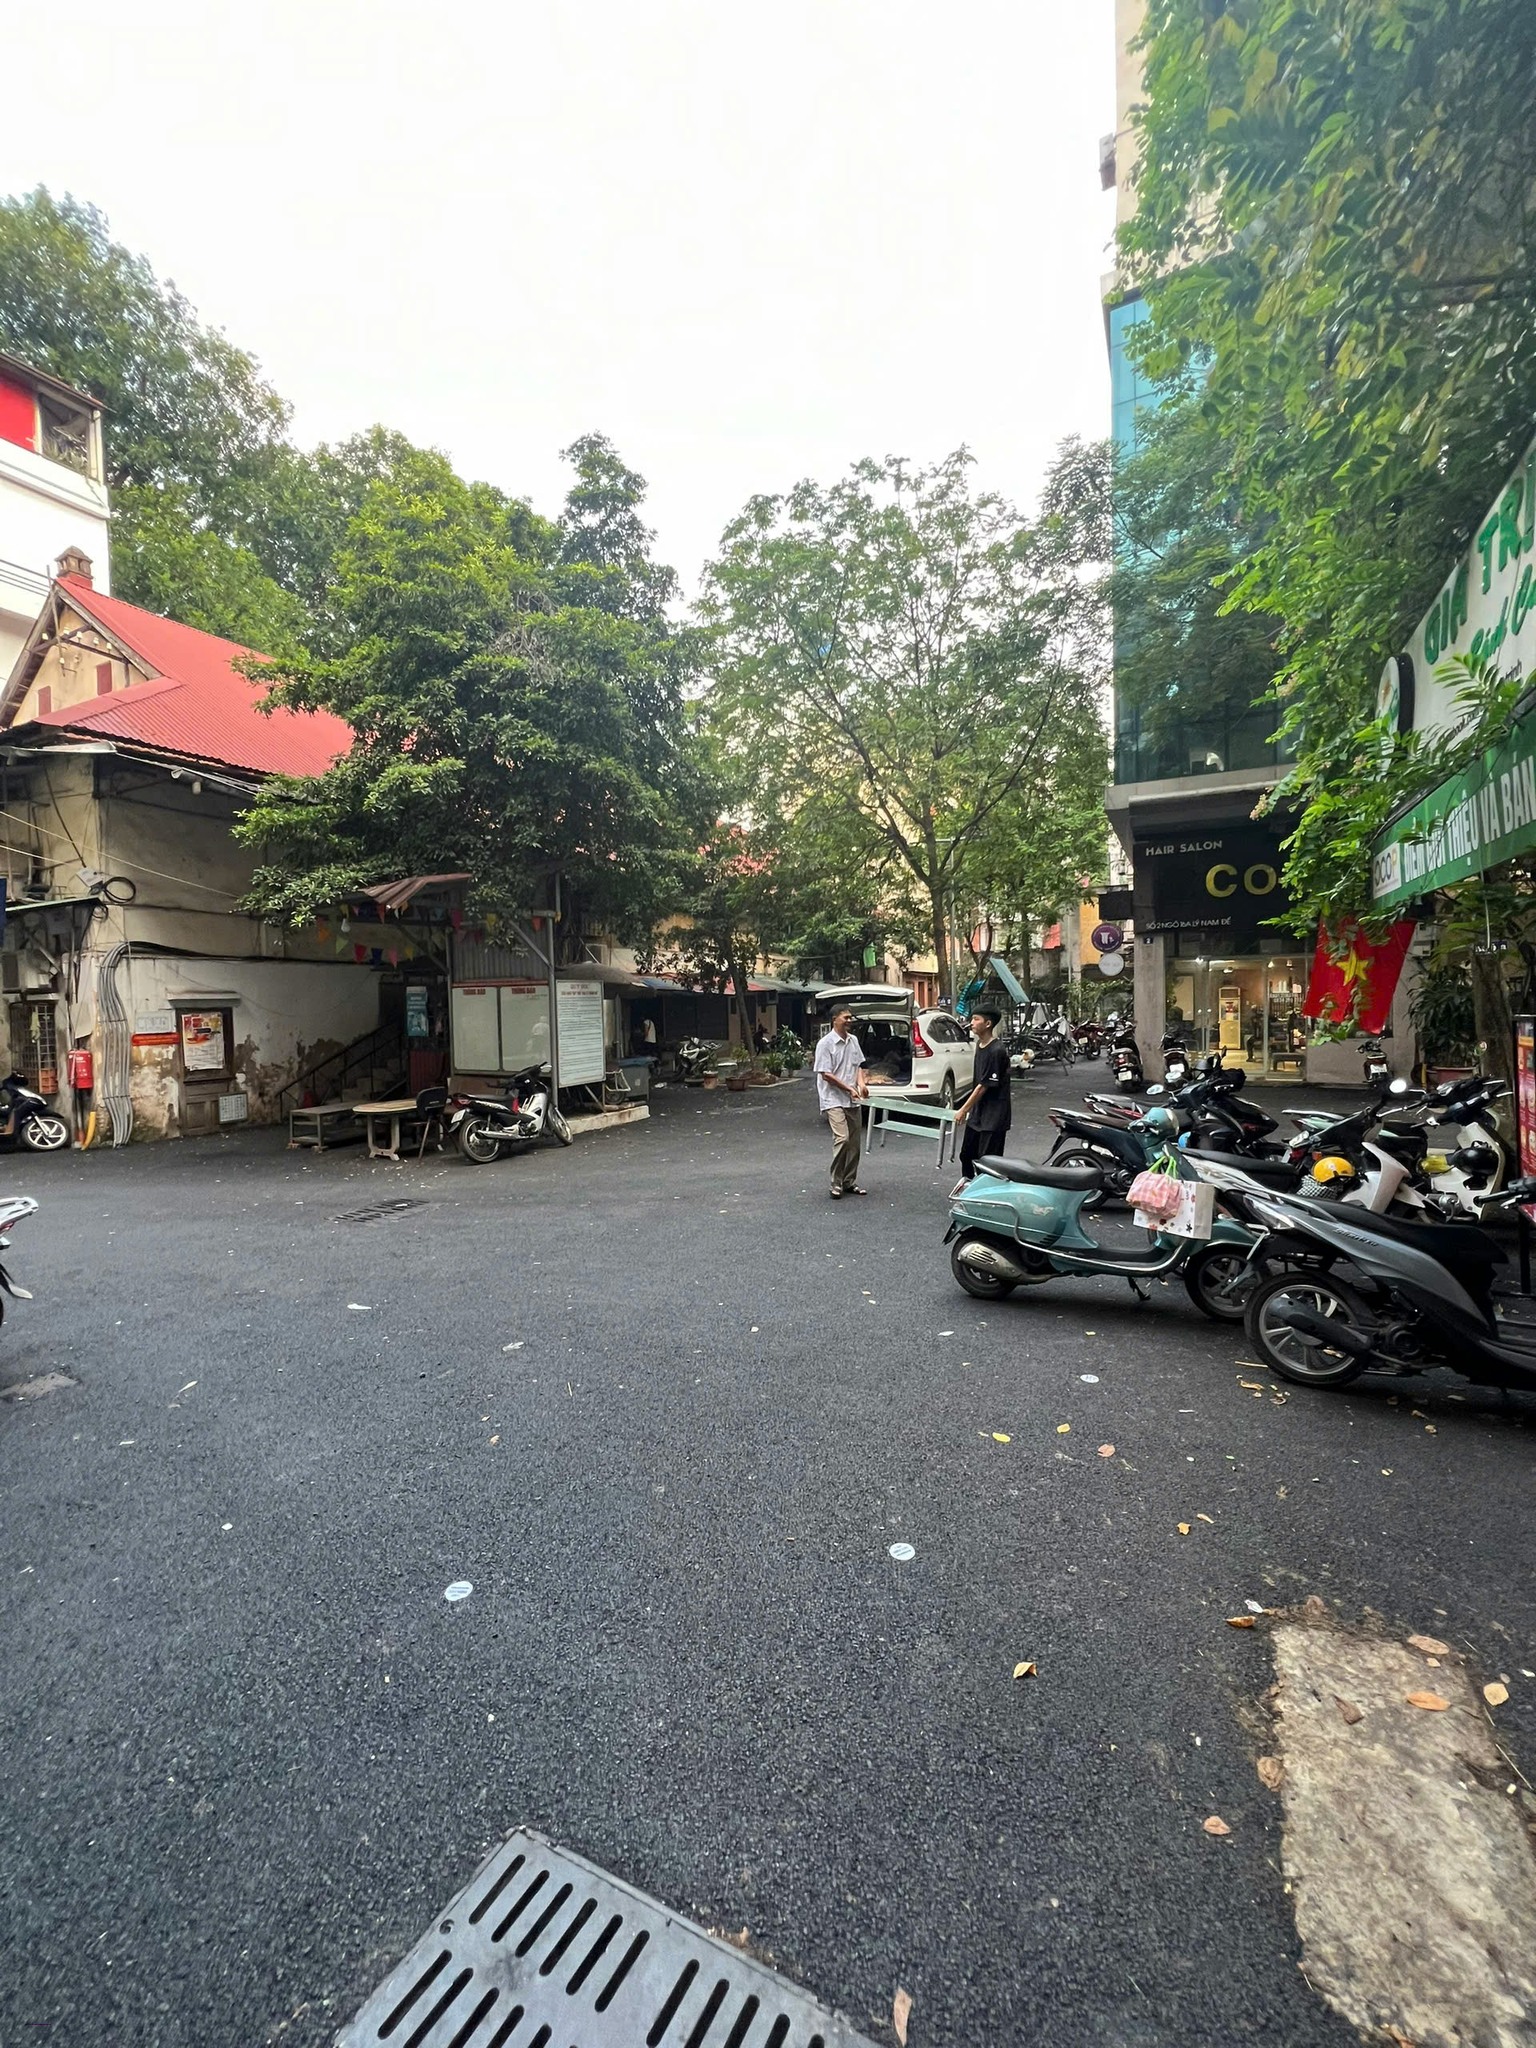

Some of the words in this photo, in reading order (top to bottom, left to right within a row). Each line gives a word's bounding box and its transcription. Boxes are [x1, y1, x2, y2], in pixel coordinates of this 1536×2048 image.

[1424, 556, 1469, 666] GIA
[1446, 788, 1480, 867] THIỆU
[1480, 771, 1502, 845] VÀ
[1501, 751, 1536, 835] BÁN
[1145, 845, 1175, 857] HAIR
[1180, 840, 1223, 854] SALON
[1206, 863, 1278, 898] CO
[1201, 919, 1220, 927] NAM
